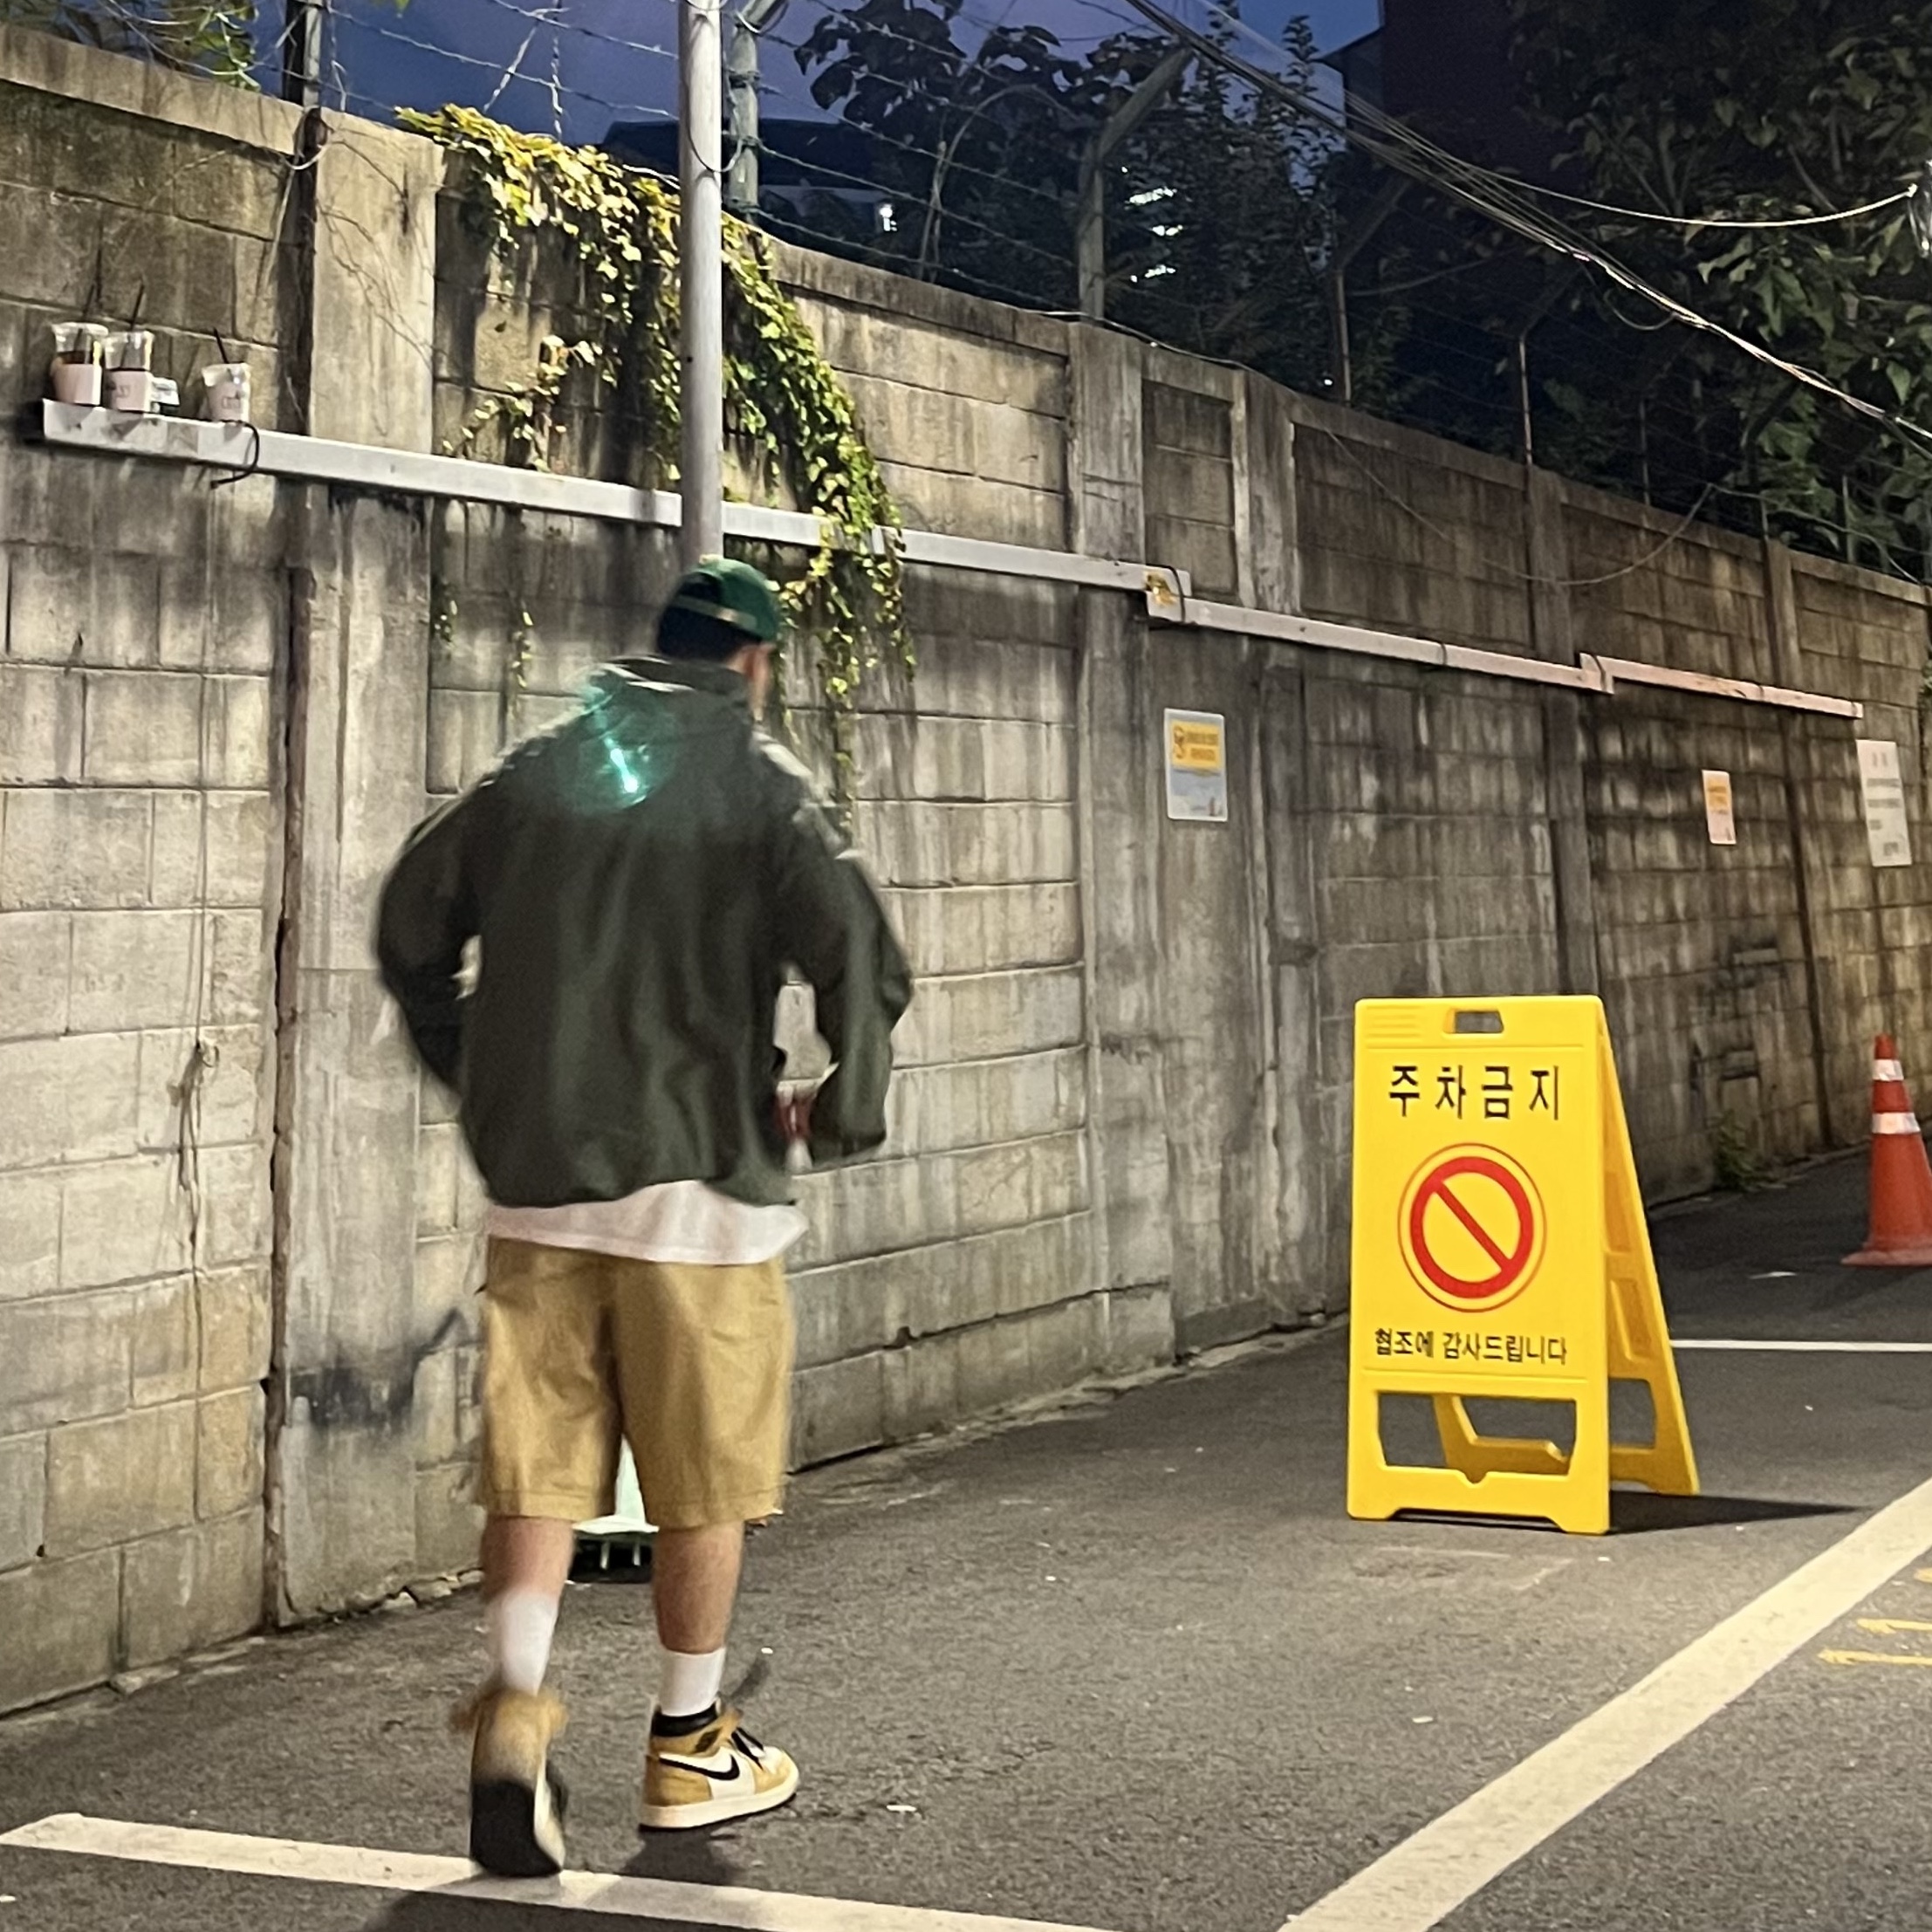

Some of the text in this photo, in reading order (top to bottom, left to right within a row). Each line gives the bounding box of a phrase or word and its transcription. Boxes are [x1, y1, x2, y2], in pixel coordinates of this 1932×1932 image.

[1388, 1065, 1559, 1120] 주차금지
[1374, 1327, 1567, 1366] 협조에 감사드립니다
